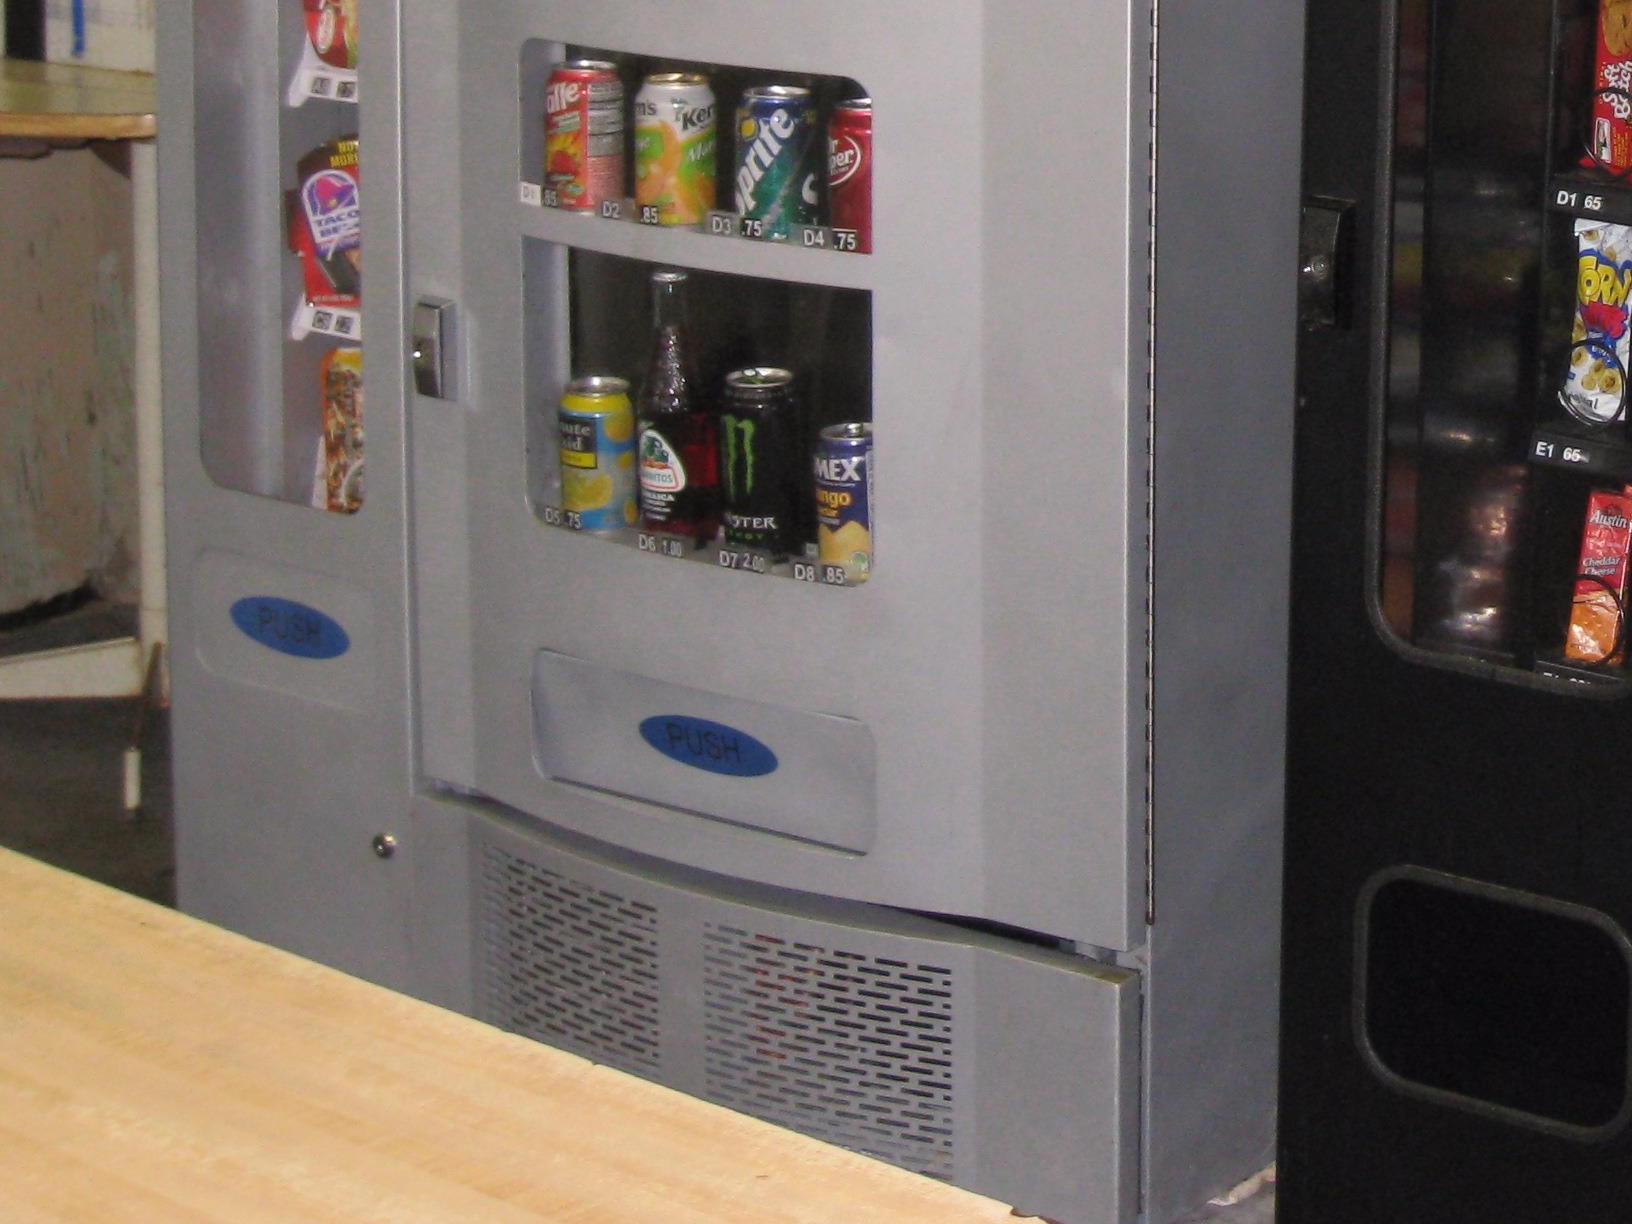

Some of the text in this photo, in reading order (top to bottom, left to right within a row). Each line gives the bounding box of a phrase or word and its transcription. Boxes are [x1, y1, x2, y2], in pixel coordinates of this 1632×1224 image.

[1556, 190, 1603, 211] D1 65
[603, 200, 659, 224] D2 .85
[712, 215, 763, 237] D3 .75
[804, 229, 857, 250] D4 .75
[1535, 441, 1554, 458] E1
[1590, 509, 1627, 529] Austin
[638, 533, 656, 553] D6
[719, 550, 766, 574] D7 2.00
[1582, 556, 1621, 567] Cheddar
[1584, 565, 1616, 576] Cheese
[794, 564, 815, 582] D8
[665, 722, 742, 763] PUSH
